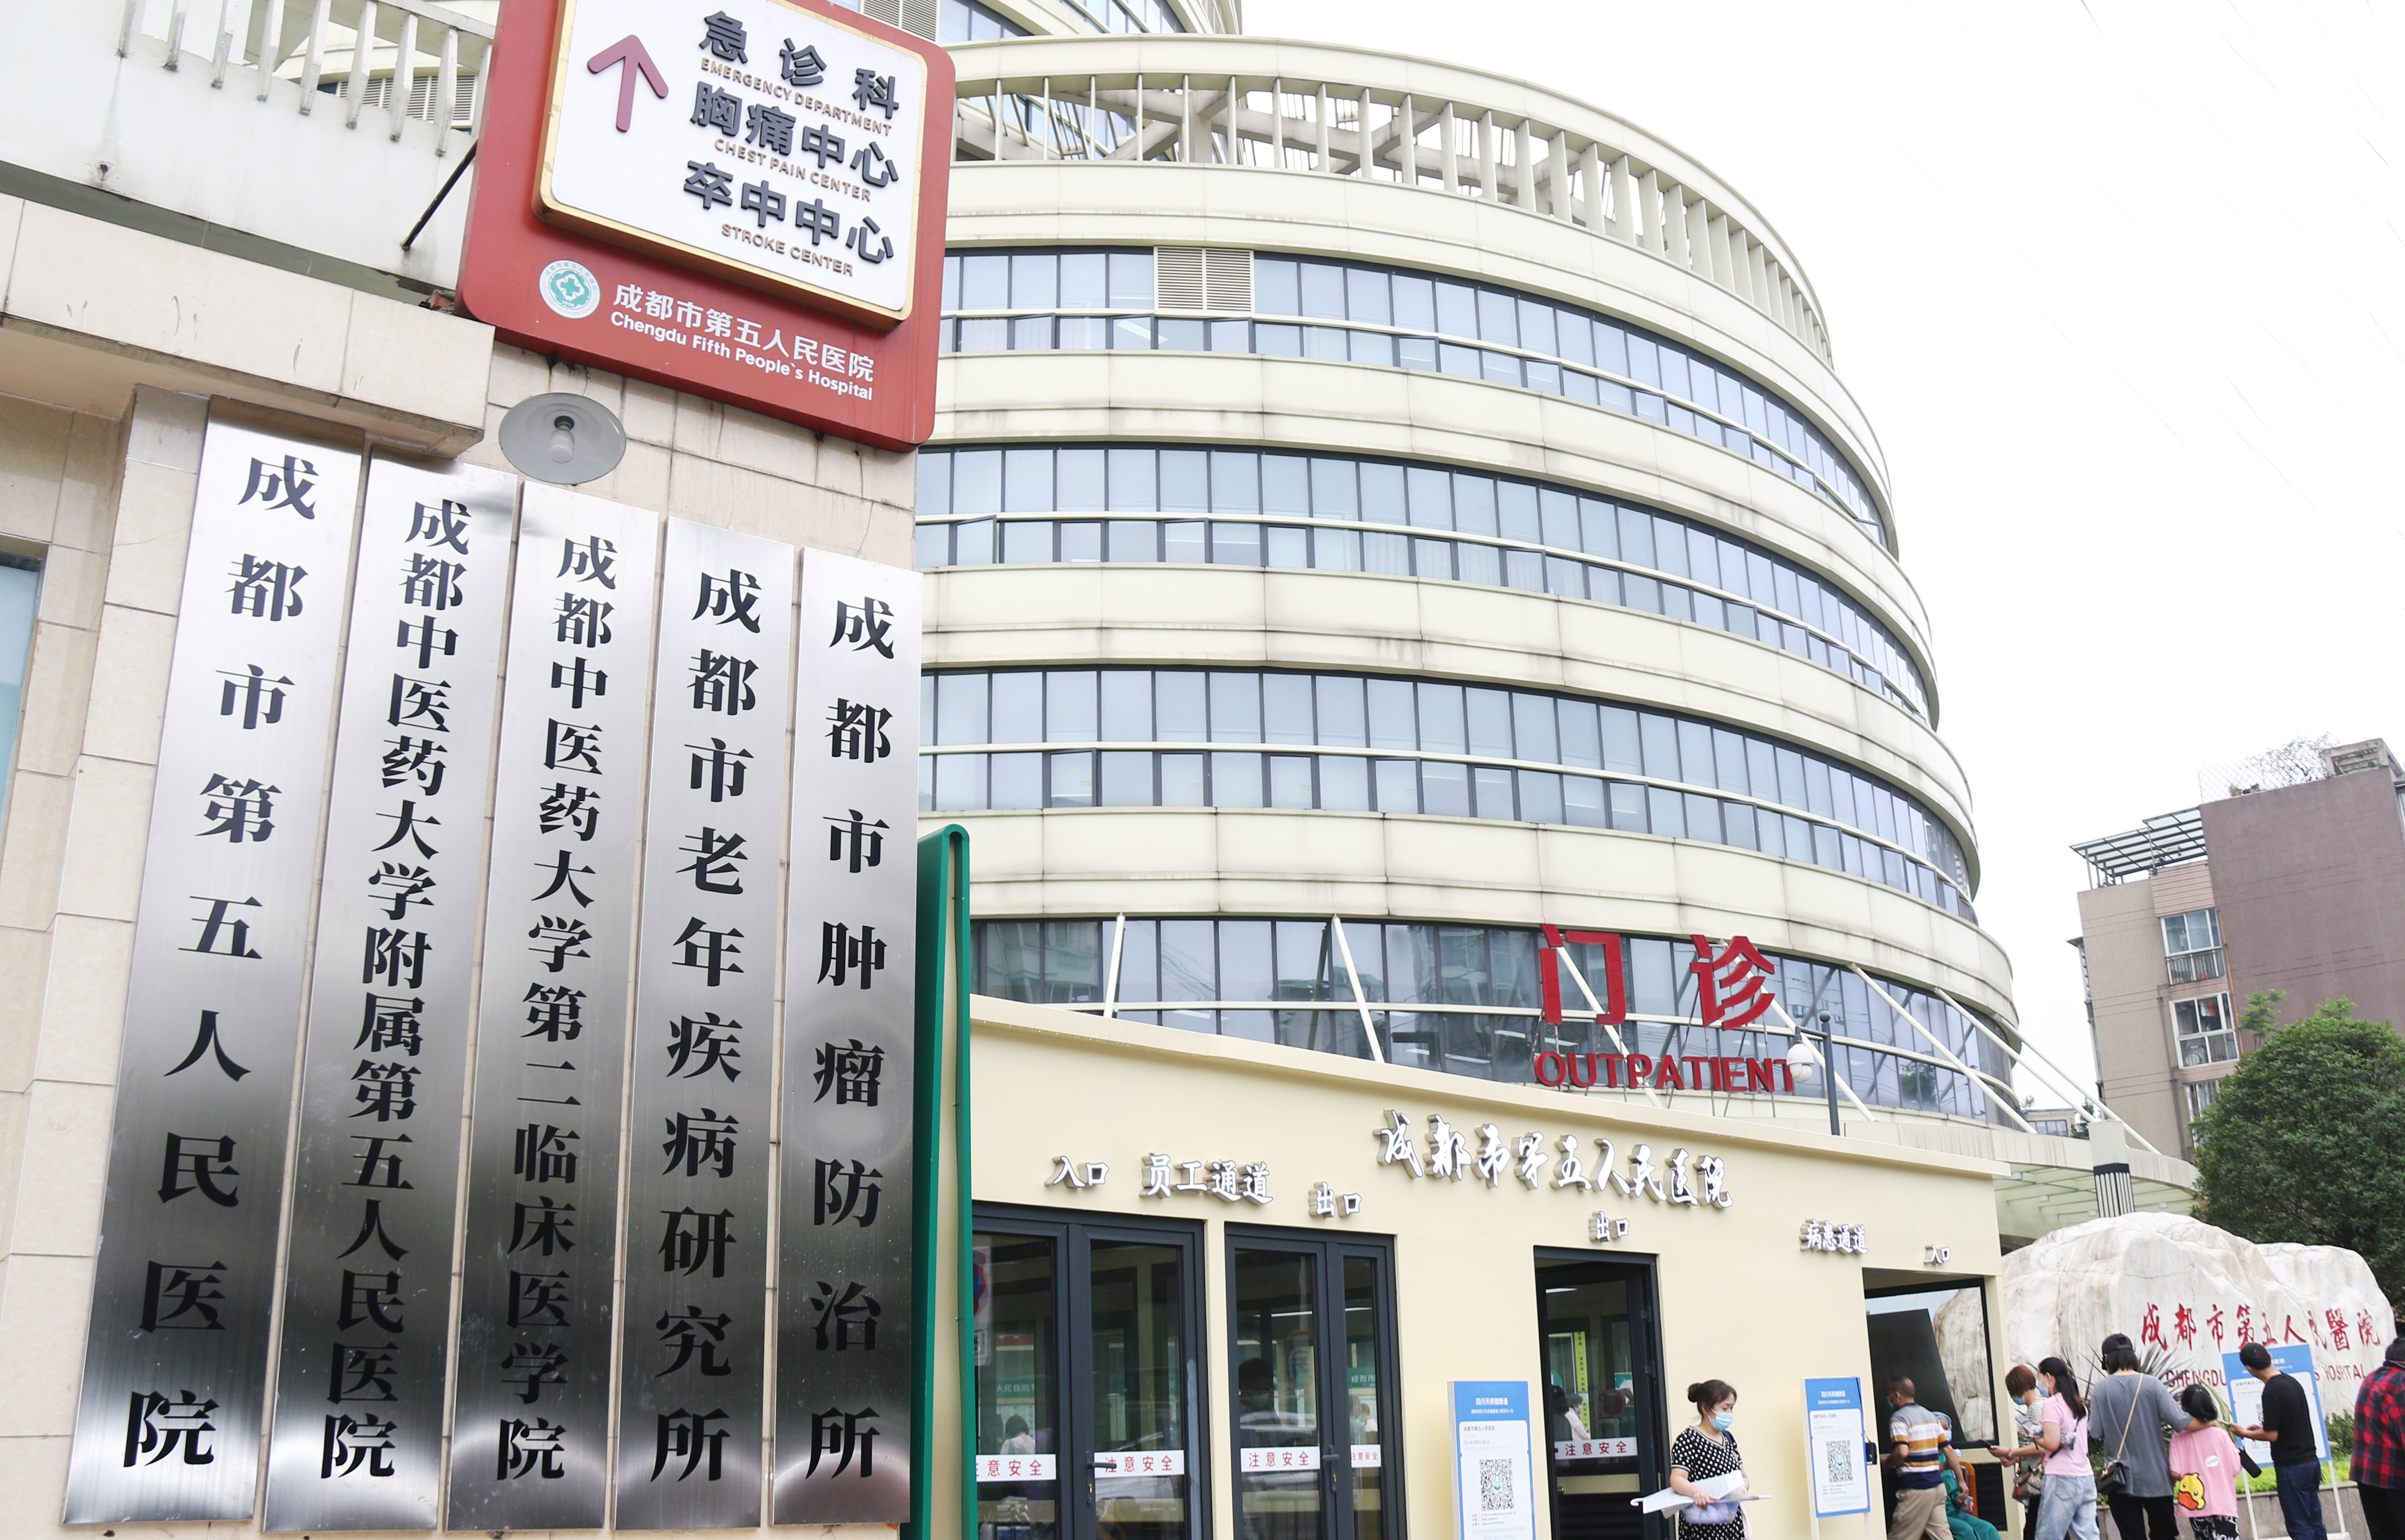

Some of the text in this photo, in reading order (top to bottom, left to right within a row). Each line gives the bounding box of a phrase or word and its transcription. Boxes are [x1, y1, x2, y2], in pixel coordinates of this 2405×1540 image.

[699, 11, 899, 119] 急诊科
[702, 58, 892, 136] EMERGENCY DEPARTMENT
[690, 81, 898, 187] 胸痛中心
[715, 138, 871, 201] CHEST PAIN CENTER
[683, 160, 894, 264] 卒中中心
[721, 223, 853, 276] STROKE CENTER
[610, 311, 687, 346] Chengdu
[693, 334, 731, 359] Fifth
[808, 369, 873, 400] Hospital
[613, 283, 874, 383] 成都市第五人民医院
[124, 454, 320, 1468] 成都市第五人民医院
[321, 498, 472, 1478] 成都中医药大学附属第五人民医院
[1539, 924, 1775, 1031] 门诊
[496, 535, 618, 1480] 成都中医药大学第二临床医学院
[650, 569, 762, 1482] 成都市老年疾病研究所
[806, 596, 895, 1479] 成都市肿瘤防治所
[1534, 1051, 1794, 1092] OUTPATIENT
[1048, 1155, 1110, 1188] 入口
[1142, 1153, 1274, 1205] 员工通道
[1375, 1108, 1733, 1208] 成都市第五人民医院
[1311, 1181, 1363, 1218] 出口
[1591, 1211, 1630, 1242] 出口
[1802, 1218, 1869, 1254] 病患通道
[1926, 1244, 1951, 1265] 入口
[2141, 1302, 2380, 1353] 成都市第五人民醫院
[2166, 1369, 2228, 1388] CHENGDU
[1105, 1454, 1172, 1473] 注意安全
[1249, 1451, 1309, 1467] 注意安全
[1351, 1452, 1378, 1461] 注意安全
[1565, 1440, 1627, 1456] 注意安全
